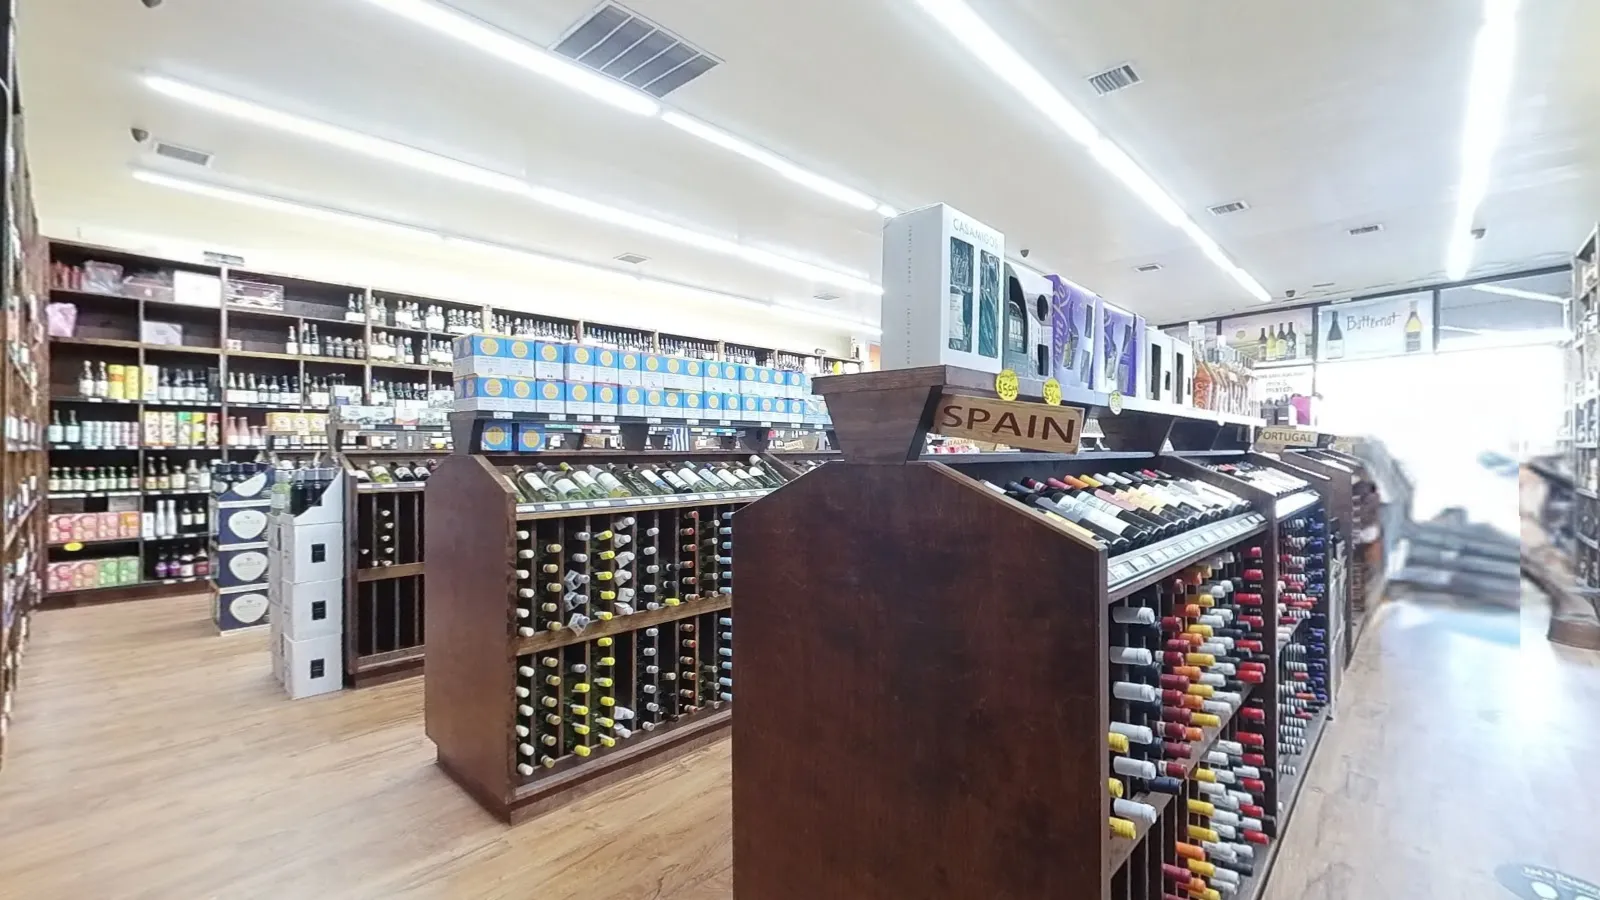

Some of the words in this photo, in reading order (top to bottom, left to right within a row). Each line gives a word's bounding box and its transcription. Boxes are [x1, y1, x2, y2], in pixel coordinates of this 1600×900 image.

[953, 217, 999, 250] CASAMIGOS
[942, 404, 1075, 444] SPAIN
[1257, 430, 1313, 443] PORTUGAL
